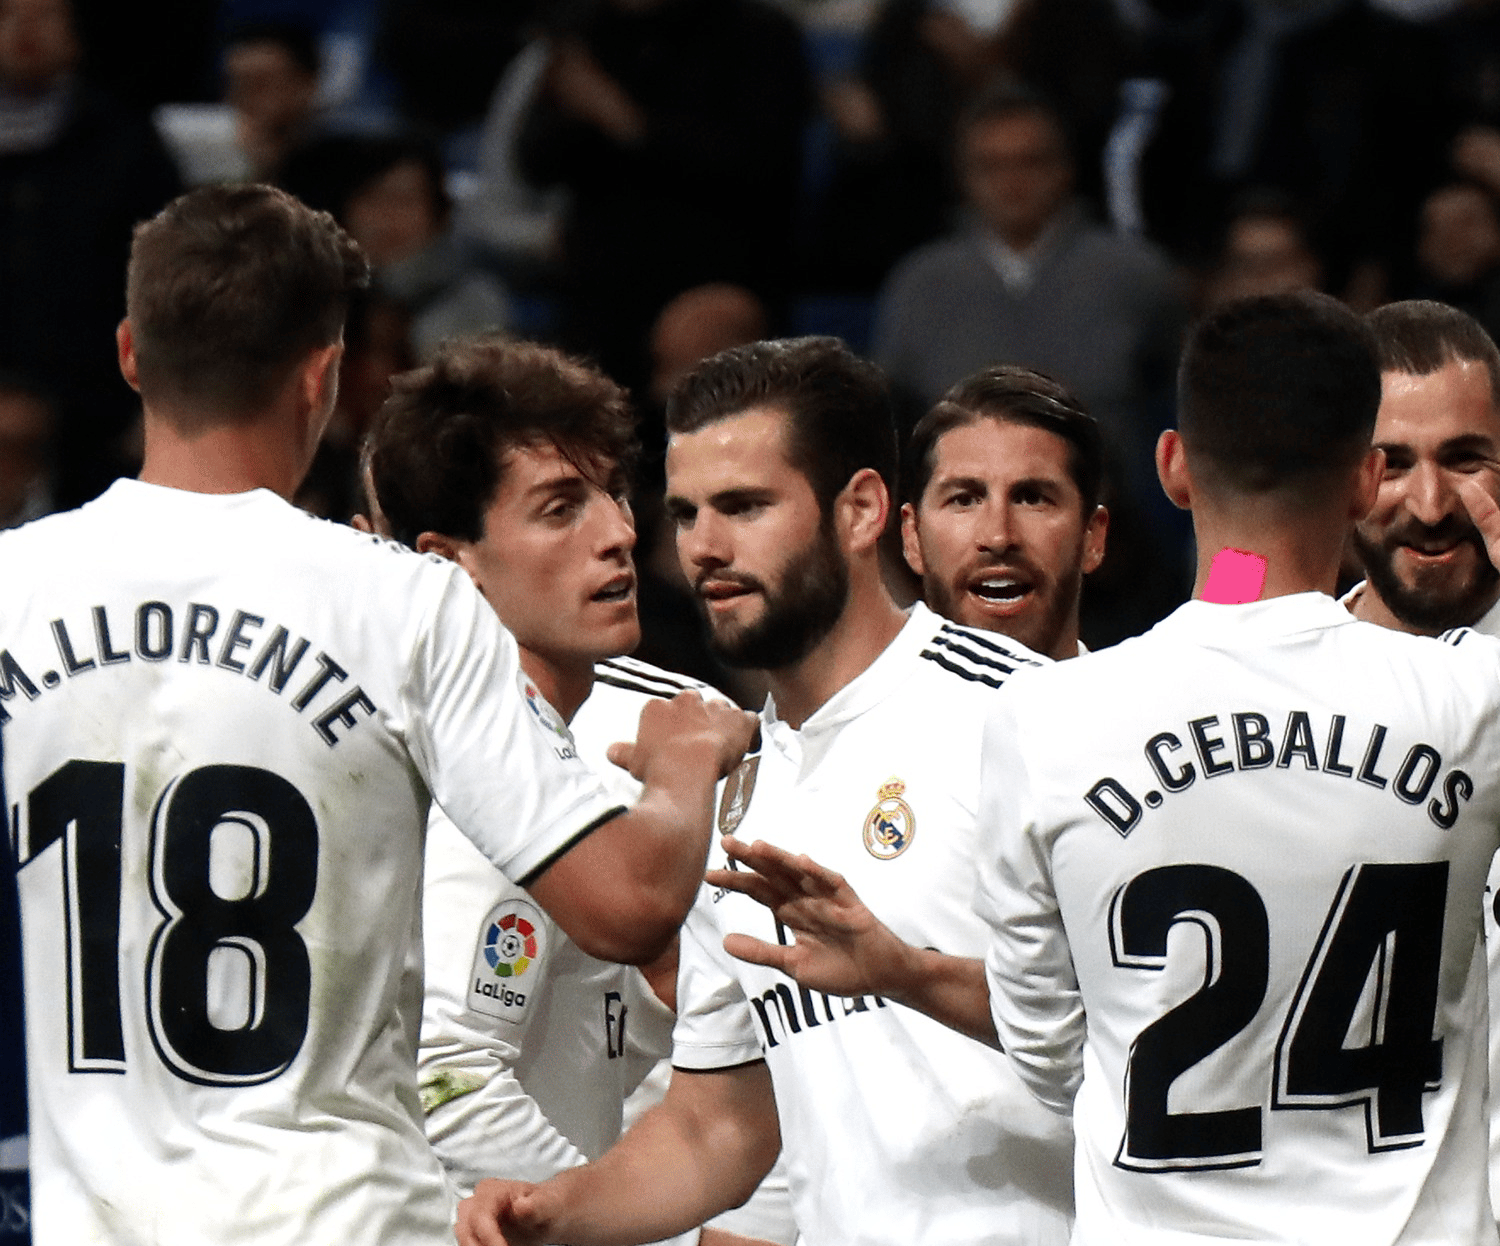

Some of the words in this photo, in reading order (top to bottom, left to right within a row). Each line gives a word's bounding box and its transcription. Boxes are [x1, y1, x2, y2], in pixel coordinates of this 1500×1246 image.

[1084, 711, 1473, 838] D.CEBALLOS
[10, 758, 319, 1087] 18
[474, 977, 526, 1007] LaLiga
[1108, 861, 1450, 1173] 24
